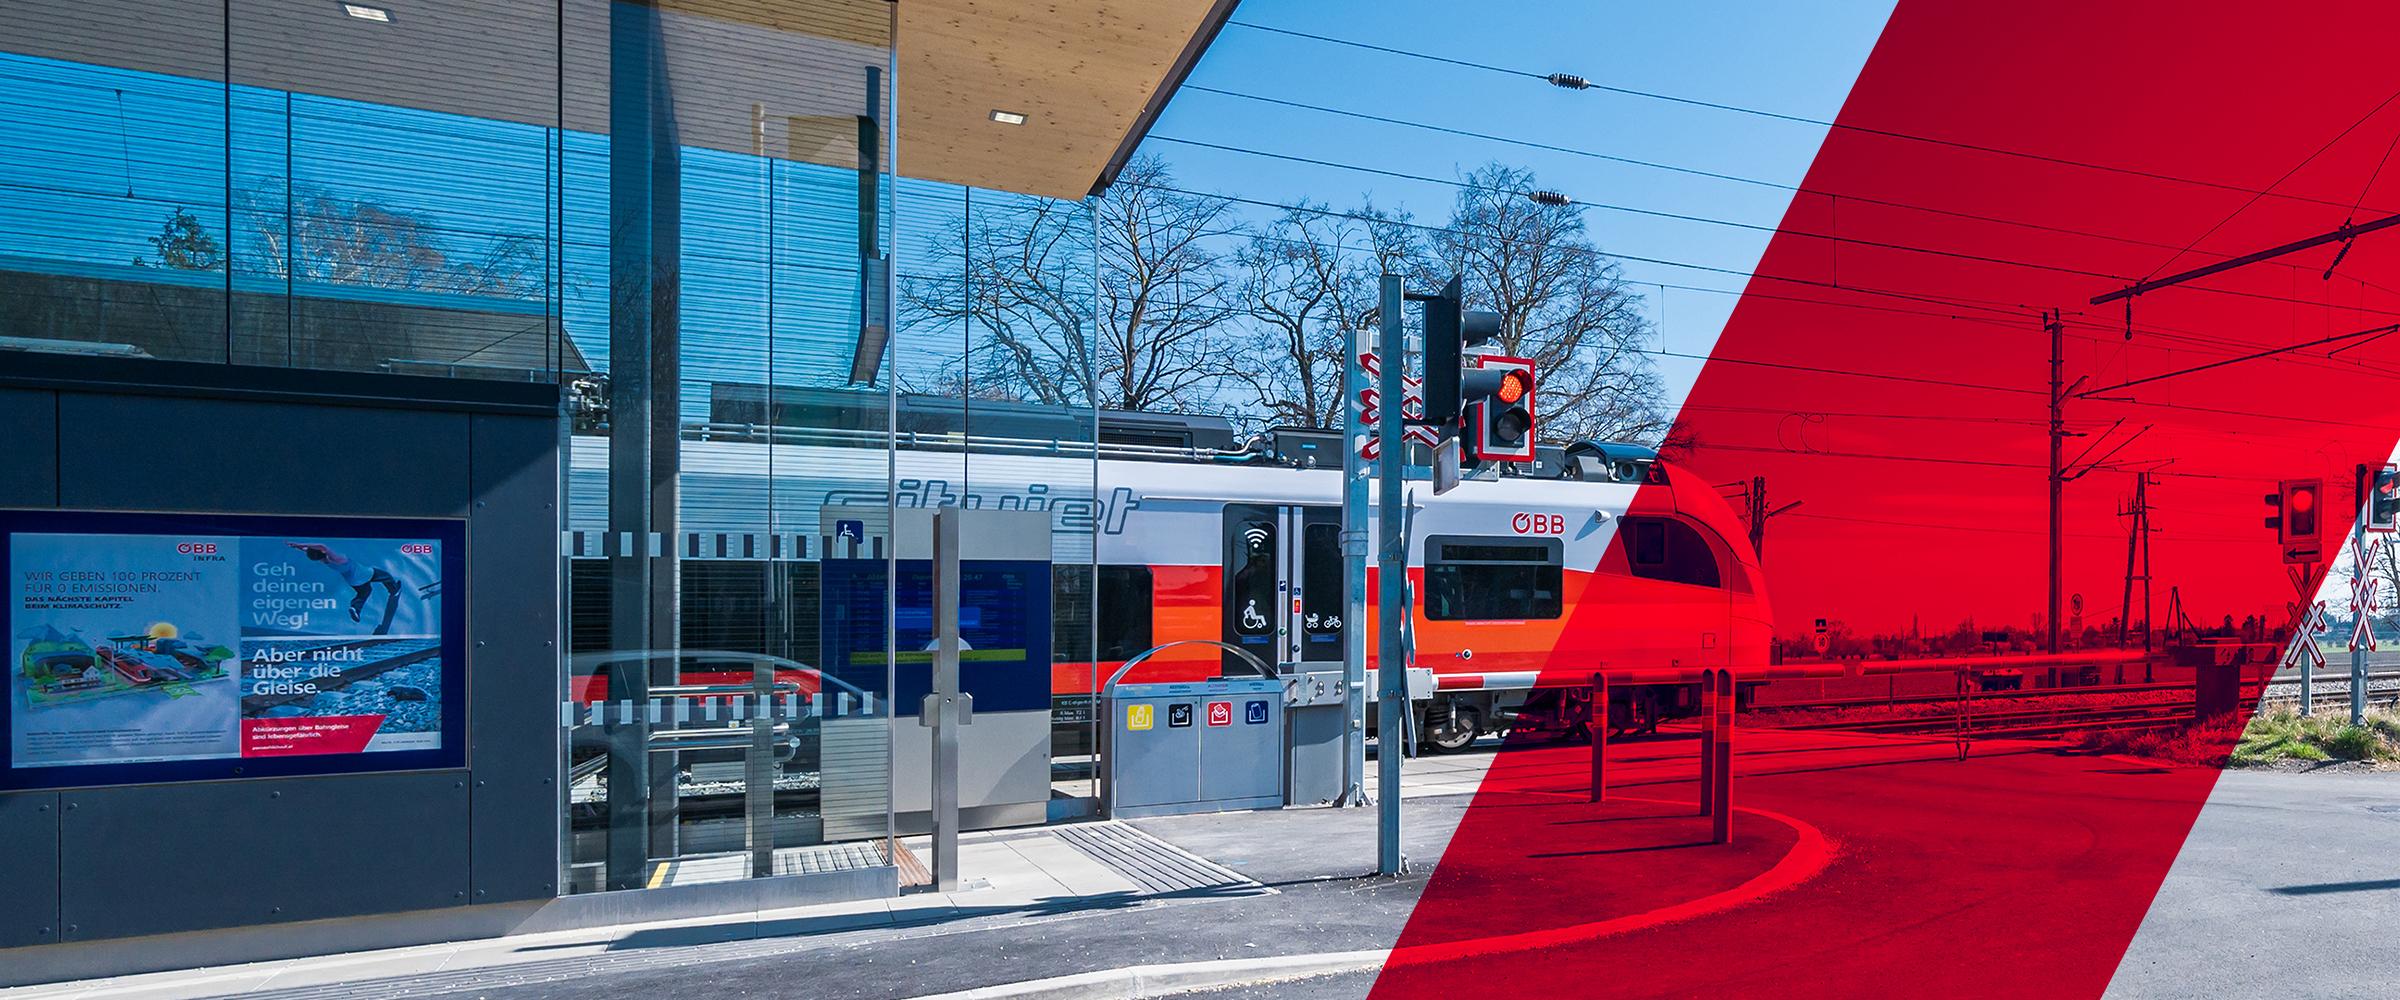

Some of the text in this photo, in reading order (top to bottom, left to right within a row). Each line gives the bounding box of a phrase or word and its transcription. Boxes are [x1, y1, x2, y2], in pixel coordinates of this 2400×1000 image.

[1511, 511, 1566, 535] ÖBB
[177, 543, 217, 554] ÖBB
[401, 544, 432, 554] ÖBB
[25, 571, 200, 581] WIR GEBEN 100 PROZENT
[253, 562, 295, 576] Geh
[25, 584, 51, 593] FÜR
[72, 584, 160, 593] EMISSIONEN.
[253, 579, 324, 593] deinen
[253, 595, 337, 613] eigenen
[253, 612, 309, 630] Weg!
[252, 647, 364, 663] Aber nicht
[253, 663, 341, 679] über die
[253, 680, 322, 696] Gleise.
